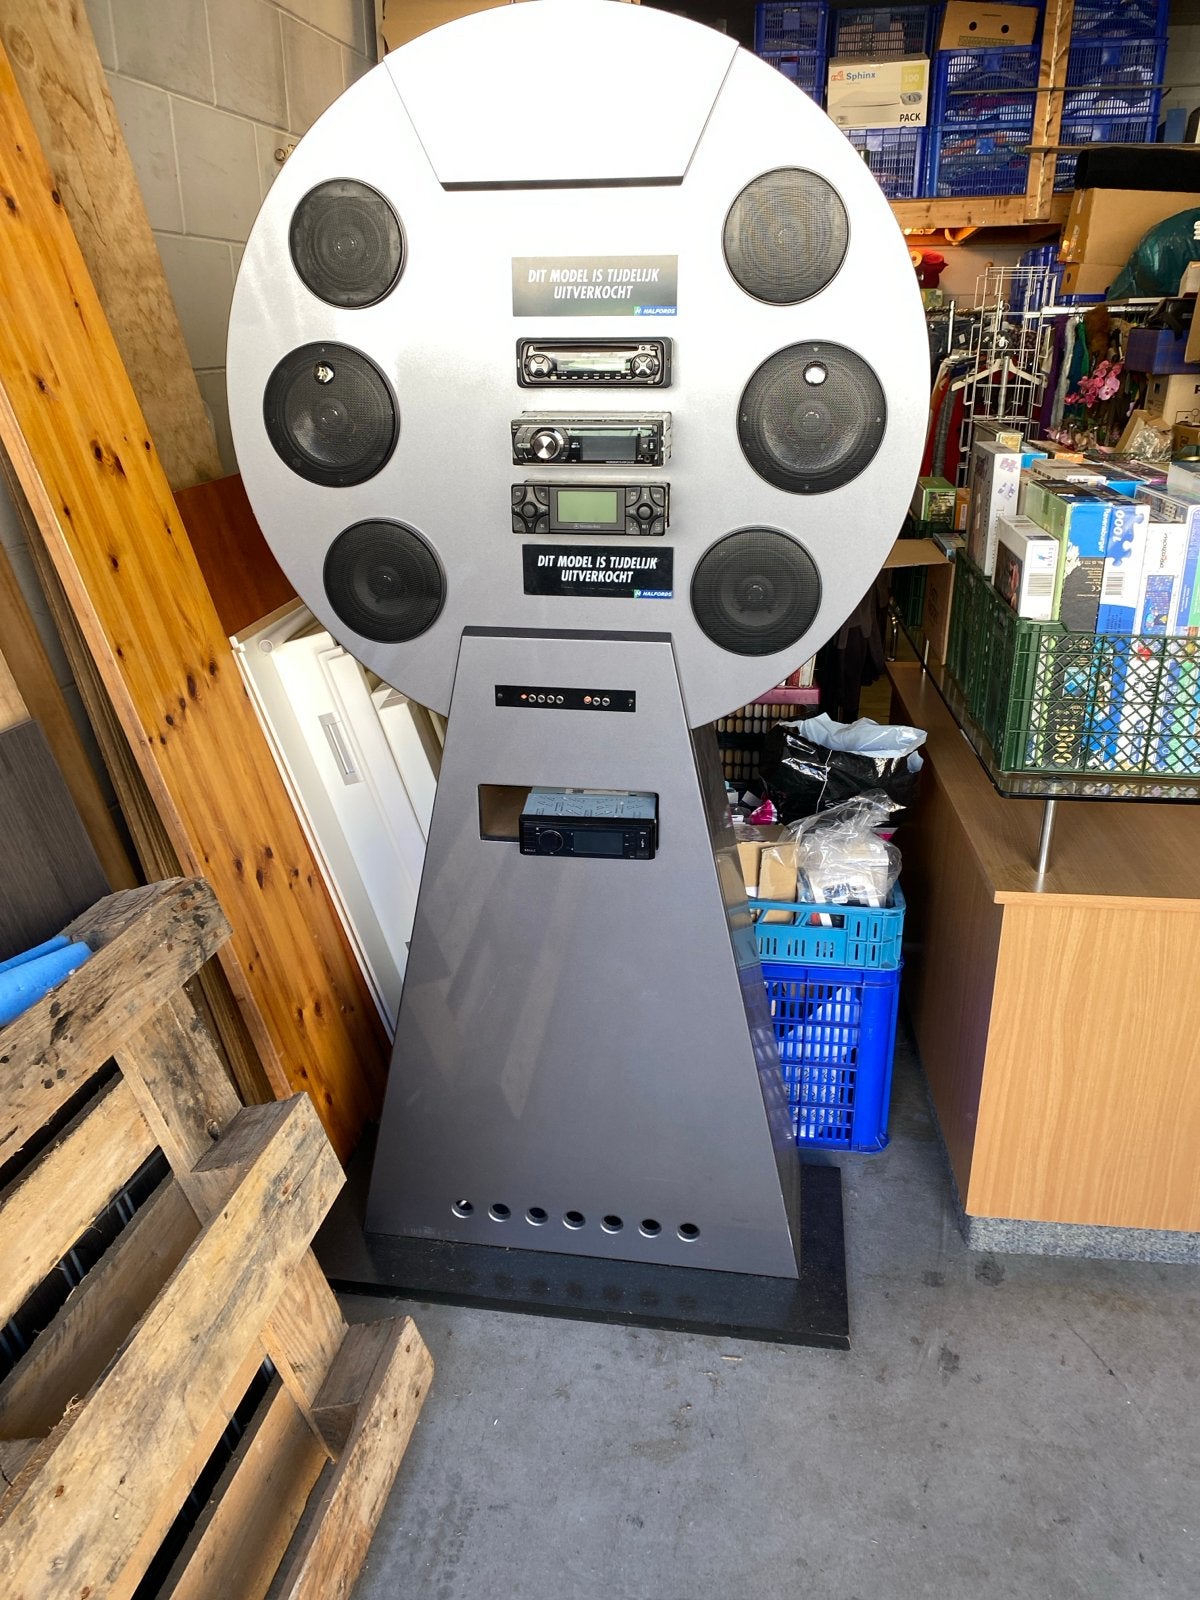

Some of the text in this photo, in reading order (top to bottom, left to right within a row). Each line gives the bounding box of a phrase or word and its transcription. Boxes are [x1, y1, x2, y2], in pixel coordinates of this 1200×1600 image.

[846, 72, 876, 82] Sphinx
[899, 112, 921, 123] PACK
[528, 268, 660, 283] DIT MODEL IS TIJDELIJK
[553, 285, 634, 299] UITVERKOCHT
[1098, 508, 1111, 553] Ravensburger
[1112, 509, 1125, 543] 1000
[537, 554, 658, 570] DIT MODEL IS TIJDELIJK
[560, 569, 634, 583] UITVERKOCHT
